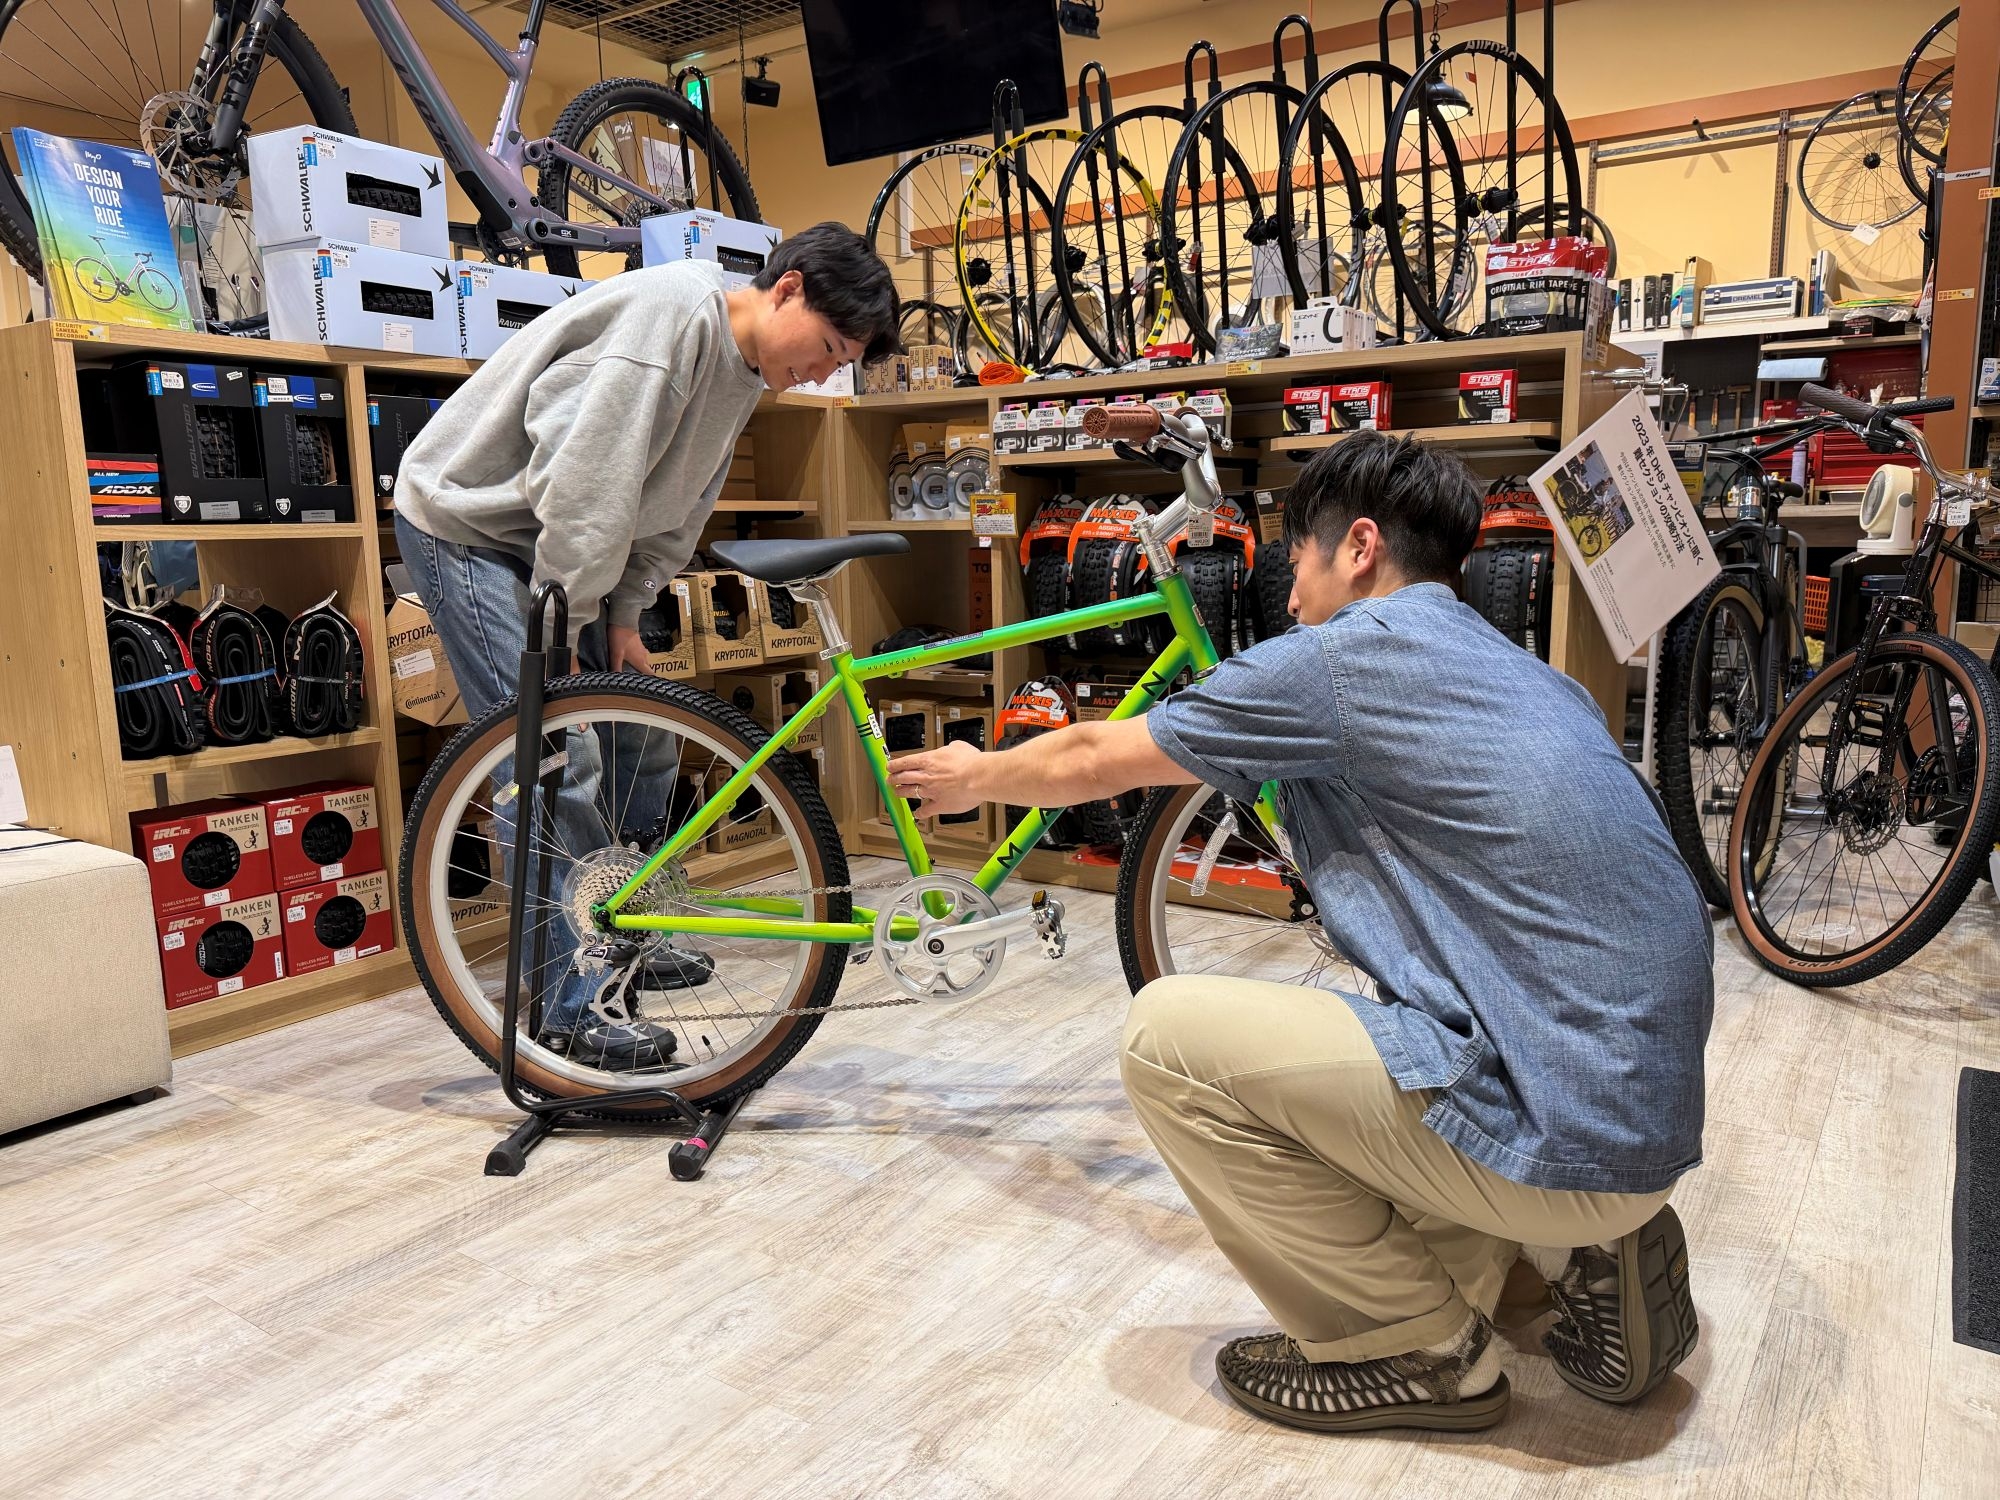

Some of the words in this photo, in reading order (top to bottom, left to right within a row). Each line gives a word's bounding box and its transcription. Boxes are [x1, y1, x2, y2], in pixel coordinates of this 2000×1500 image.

[312, 131, 344, 144] SCHWALBE
[73, 162, 124, 190] DESIGN
[85, 184, 122, 209] YOUR
[298, 152, 313, 233] SCHWALBE
[93, 205, 125, 228] RIDE
[1490, 282, 1527, 296] ORIGINAL
[1529, 280, 1546, 289] RIM
[1549, 279, 1569, 288] TAPE
[312, 263, 328, 341] SCHWALBE
[499, 318, 526, 329] RAVITY
[55, 332, 89, 340] RECORDING
[183, 403, 199, 479] EVOLUTION
[1631, 415, 1650, 447] 2023
[1645, 445, 1655, 458] 年
[1650, 456, 1667, 483] DHS
[97, 485, 155, 495] ADDIX
[1040, 508, 1082, 518] MAXXIS
[1090, 507, 1138, 520] MAXXIS
[1098, 524, 1125, 532] ASSEGAI
[387, 624, 437, 650] RYPTOTA
[771, 635, 817, 649] KRYPTOTAL
[714, 649, 758, 662] KRYPTOTAL
[650, 660, 690, 674] YPTOTAL
[405, 689, 446, 710] Continental
[1011, 695, 1054, 707] MAXXIS
[1093, 697, 1120, 706] MAXX
[328, 792, 370, 808] TANKEN
[211, 812, 260, 829] TANKEN
[726, 826, 768, 845] MAGNOTAL
[340, 876, 383, 893] TANKEN
[225, 899, 273, 918] TANKEN
[450, 899, 499, 923] RYPTOTAL
[1788, 959, 1843, 968] KENDA
